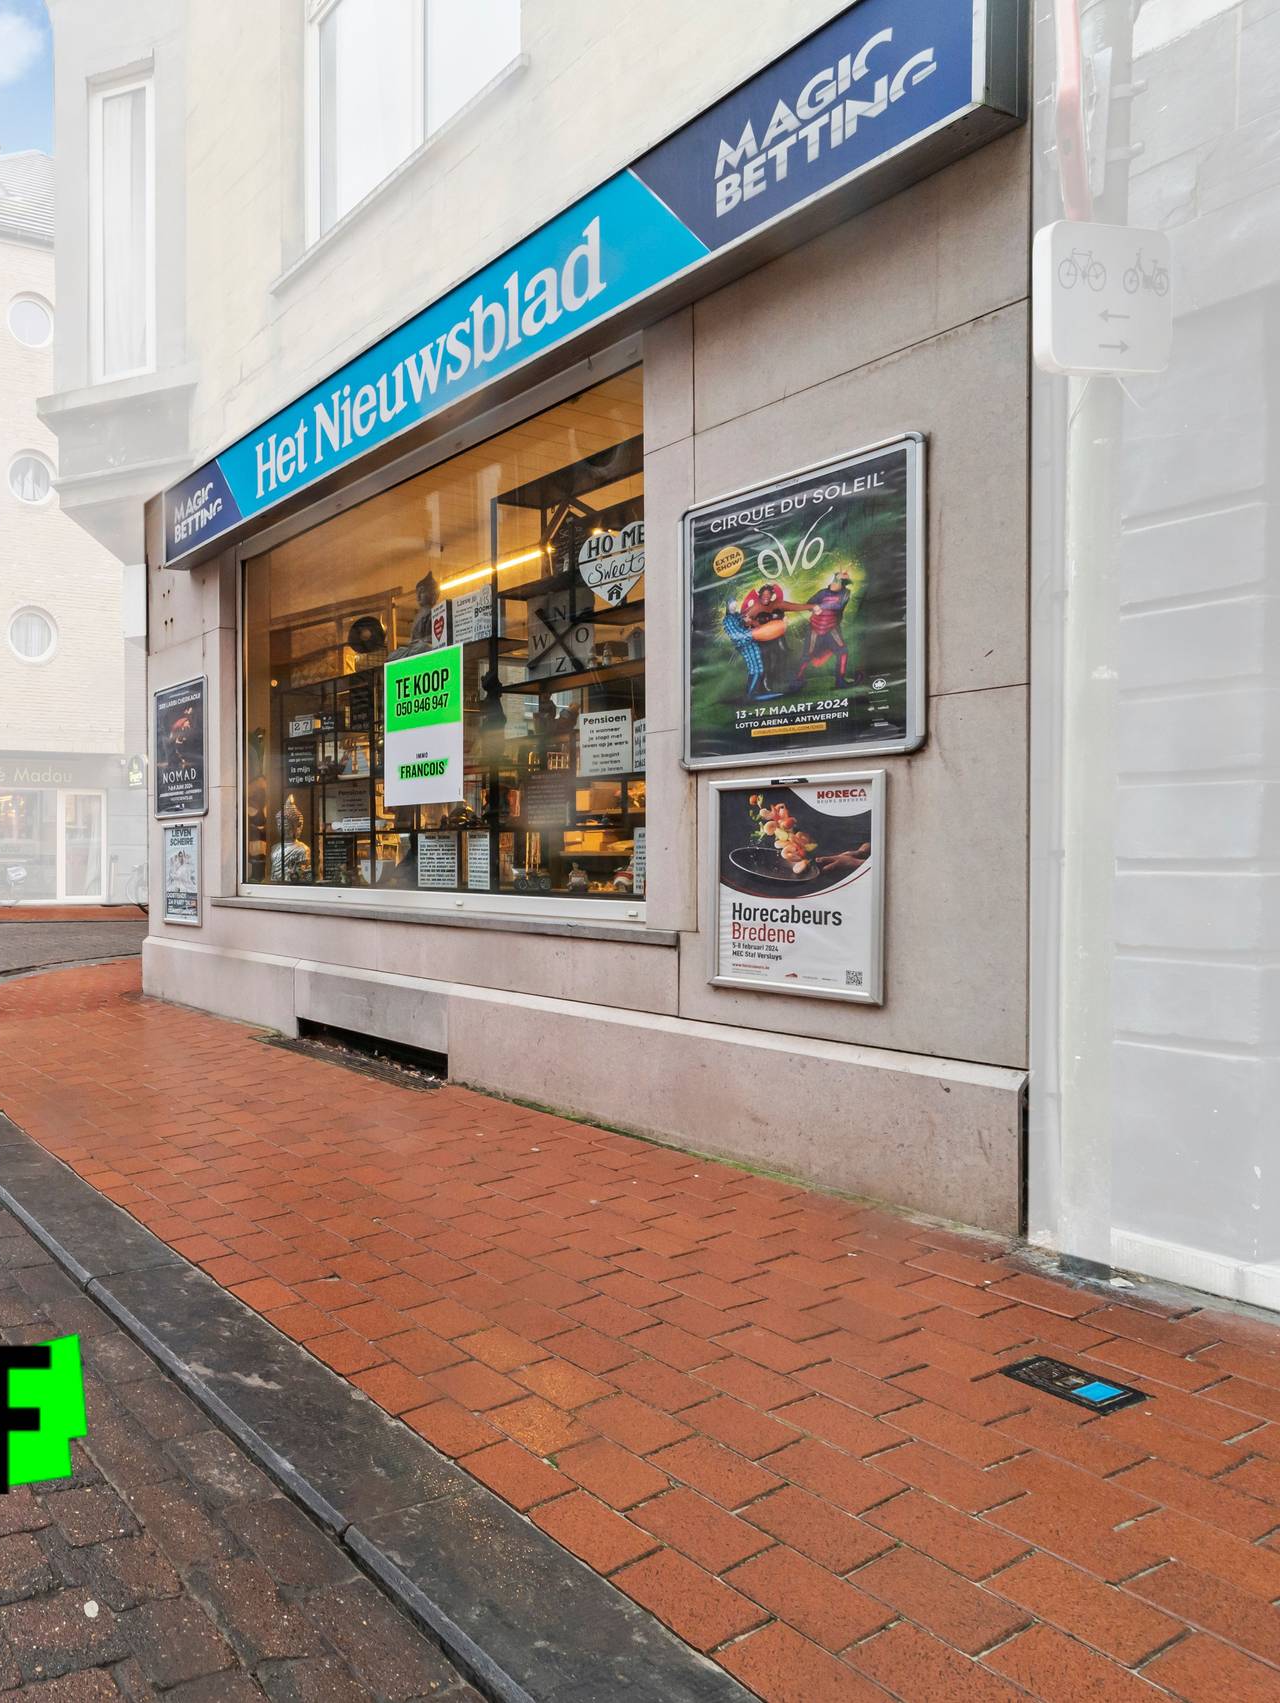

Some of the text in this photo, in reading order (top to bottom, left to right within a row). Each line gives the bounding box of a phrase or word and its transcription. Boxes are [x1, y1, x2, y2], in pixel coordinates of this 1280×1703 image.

[714, 27, 893, 180] MAGIC
[716, 47, 937, 218] BETTING
[255, 216, 606, 499] Het Nieuwsblad
[174, 482, 214, 524] MAGIC
[710, 473, 884, 533] CIRQUE DU SOLEIL
[174, 497, 223, 544] BETTING
[714, 551, 741, 566] EXTRA
[715, 558, 743, 573] SHOW!
[588, 552, 645, 585] Sweet
[553, 604, 567, 621] N
[532, 626, 590, 651] W O
[555, 656, 567, 673] Z
[395, 668, 449, 700] TE KOOP
[396, 693, 449, 717] 050 946 947
[735, 710, 747, 719] 13
[754, 708, 766, 717] 17
[769, 702, 814, 715] MAART
[816, 698, 849, 710] 2024
[583, 714, 627, 725] Pensioen
[795, 711, 849, 723] ANTWERPEN
[14, 766, 73, 783] Madou
[162, 767, 197, 785] NOMAD
[400, 761, 445, 779] FRANCOIS
[817, 788, 867, 799] HORECA
[170, 837, 194, 846] SCHEIRE
[171, 828, 192, 837] LIEVEN
[732, 902, 843, 926] Horecabeurs
[732, 921, 796, 944] Bredene
[742, 943, 765, 951] februari
[765, 944, 779, 952] 2024
